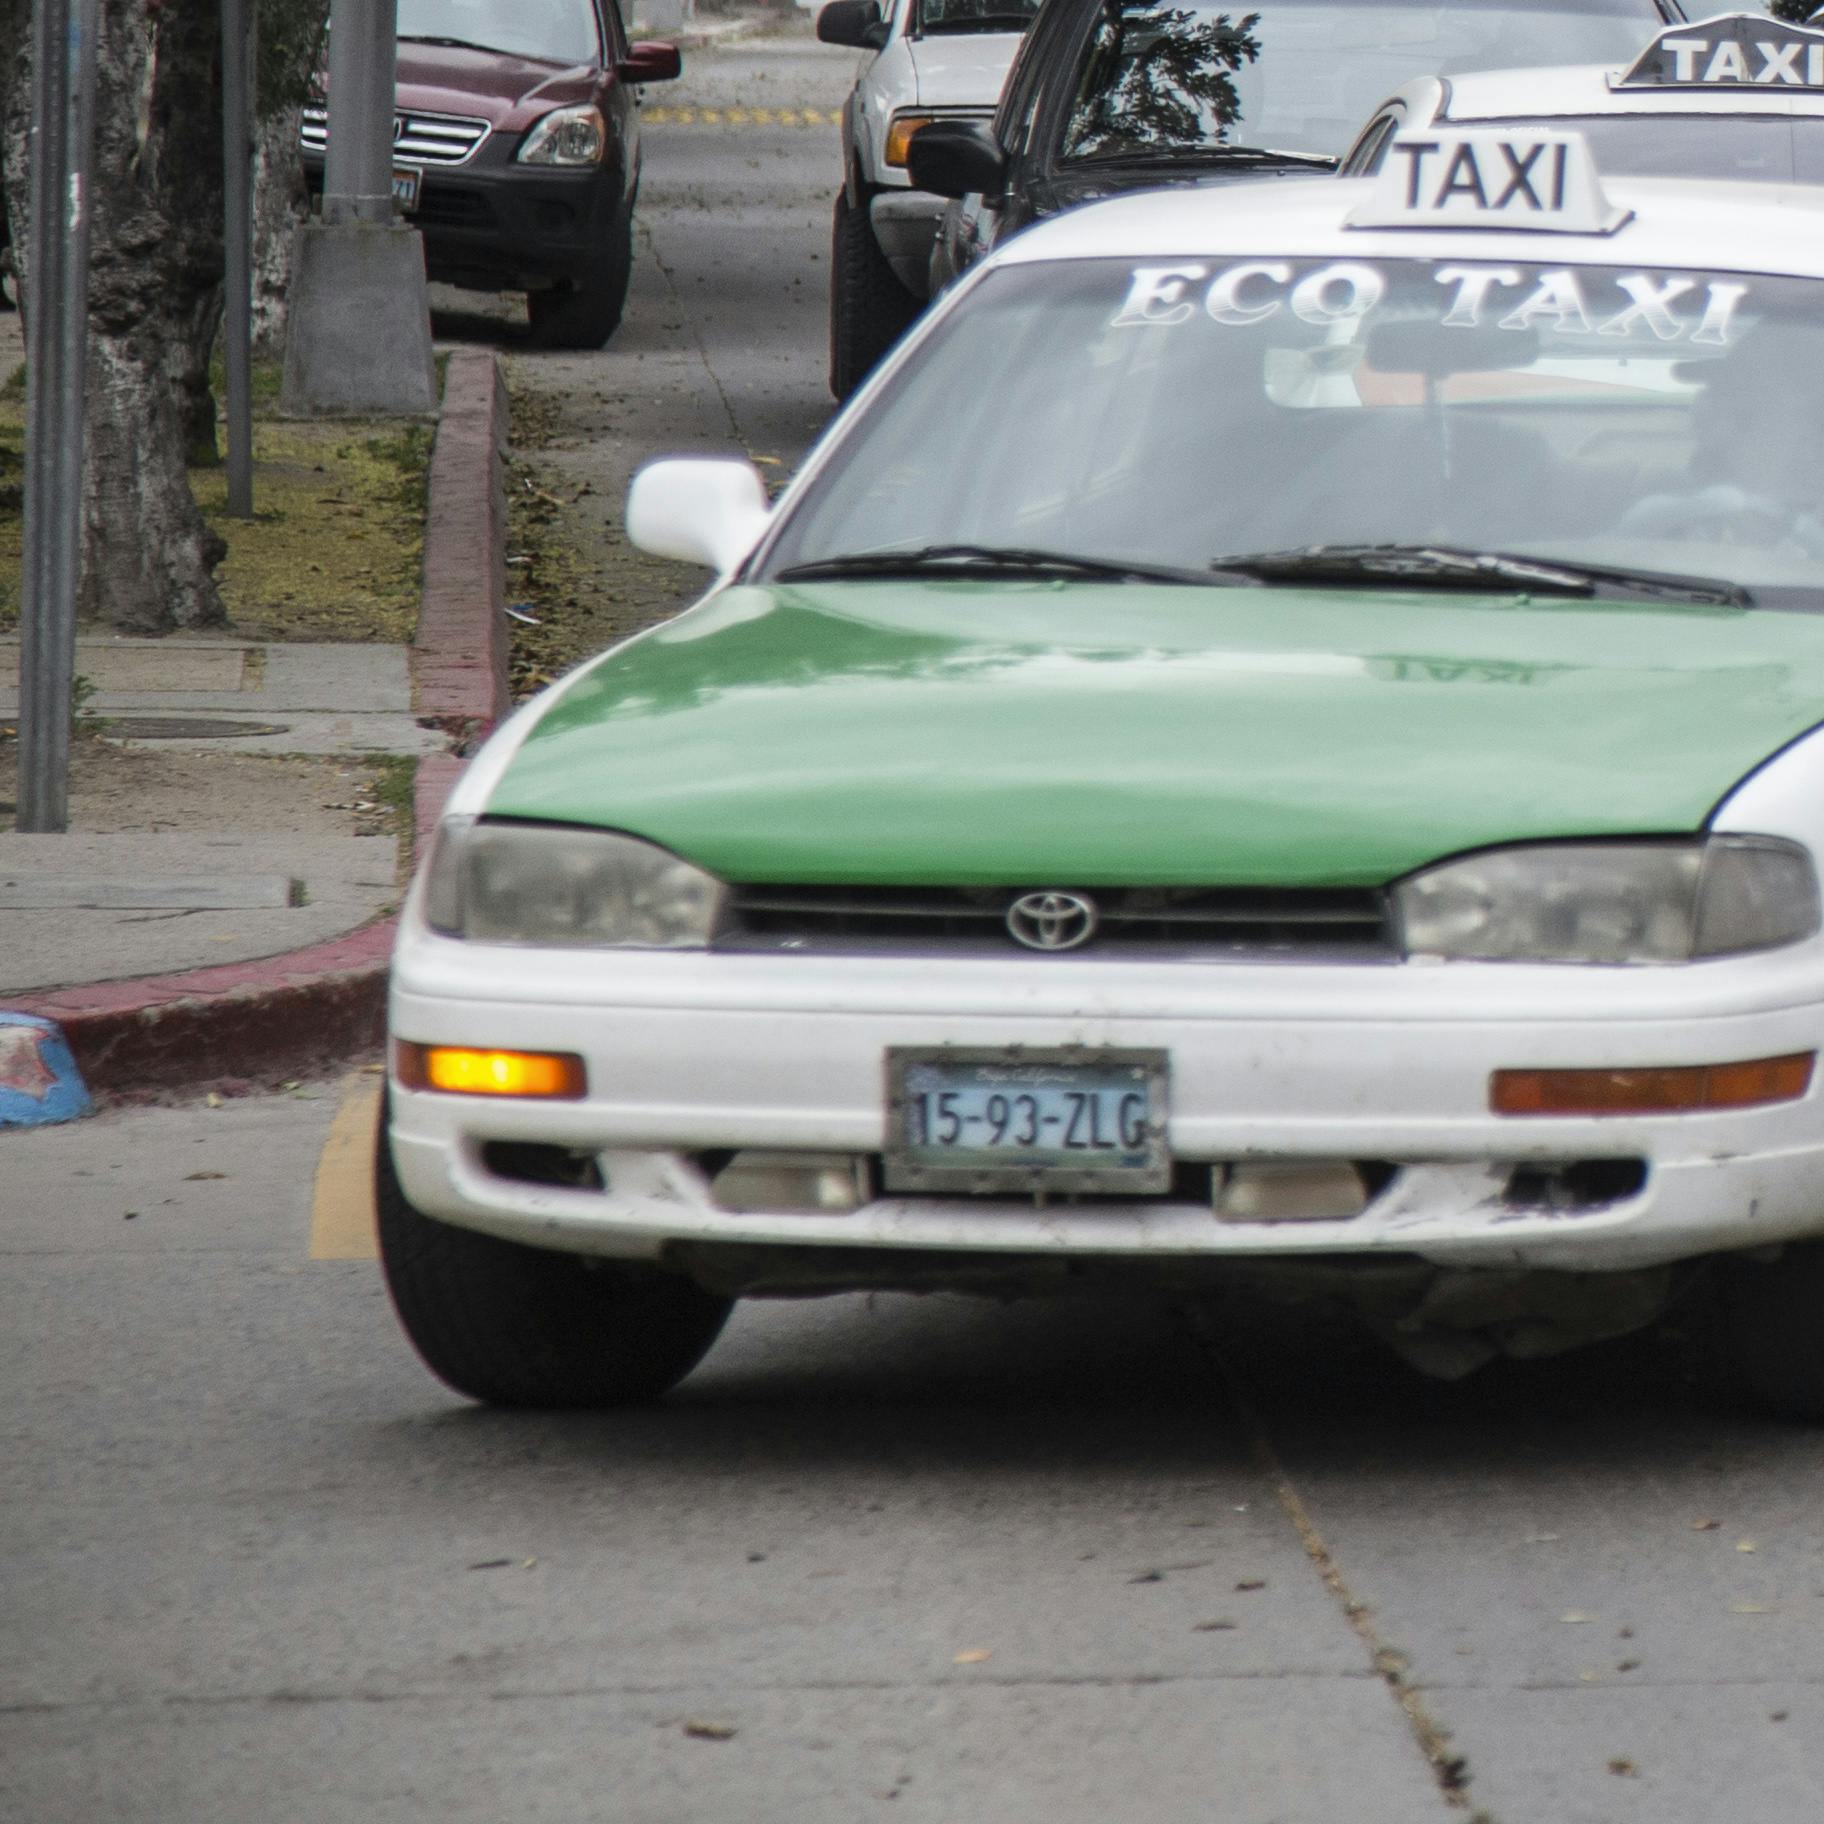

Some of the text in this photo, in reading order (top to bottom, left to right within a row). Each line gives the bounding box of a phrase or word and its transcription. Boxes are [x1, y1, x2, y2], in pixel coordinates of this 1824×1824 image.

[1662, 39, 1824, 85] TAXI
[1392, 141, 1568, 212] TAXI
[1111, 264, 1749, 346] ECO TAXI
[917, 1090, 1147, 1150] 15-93-ZLG
